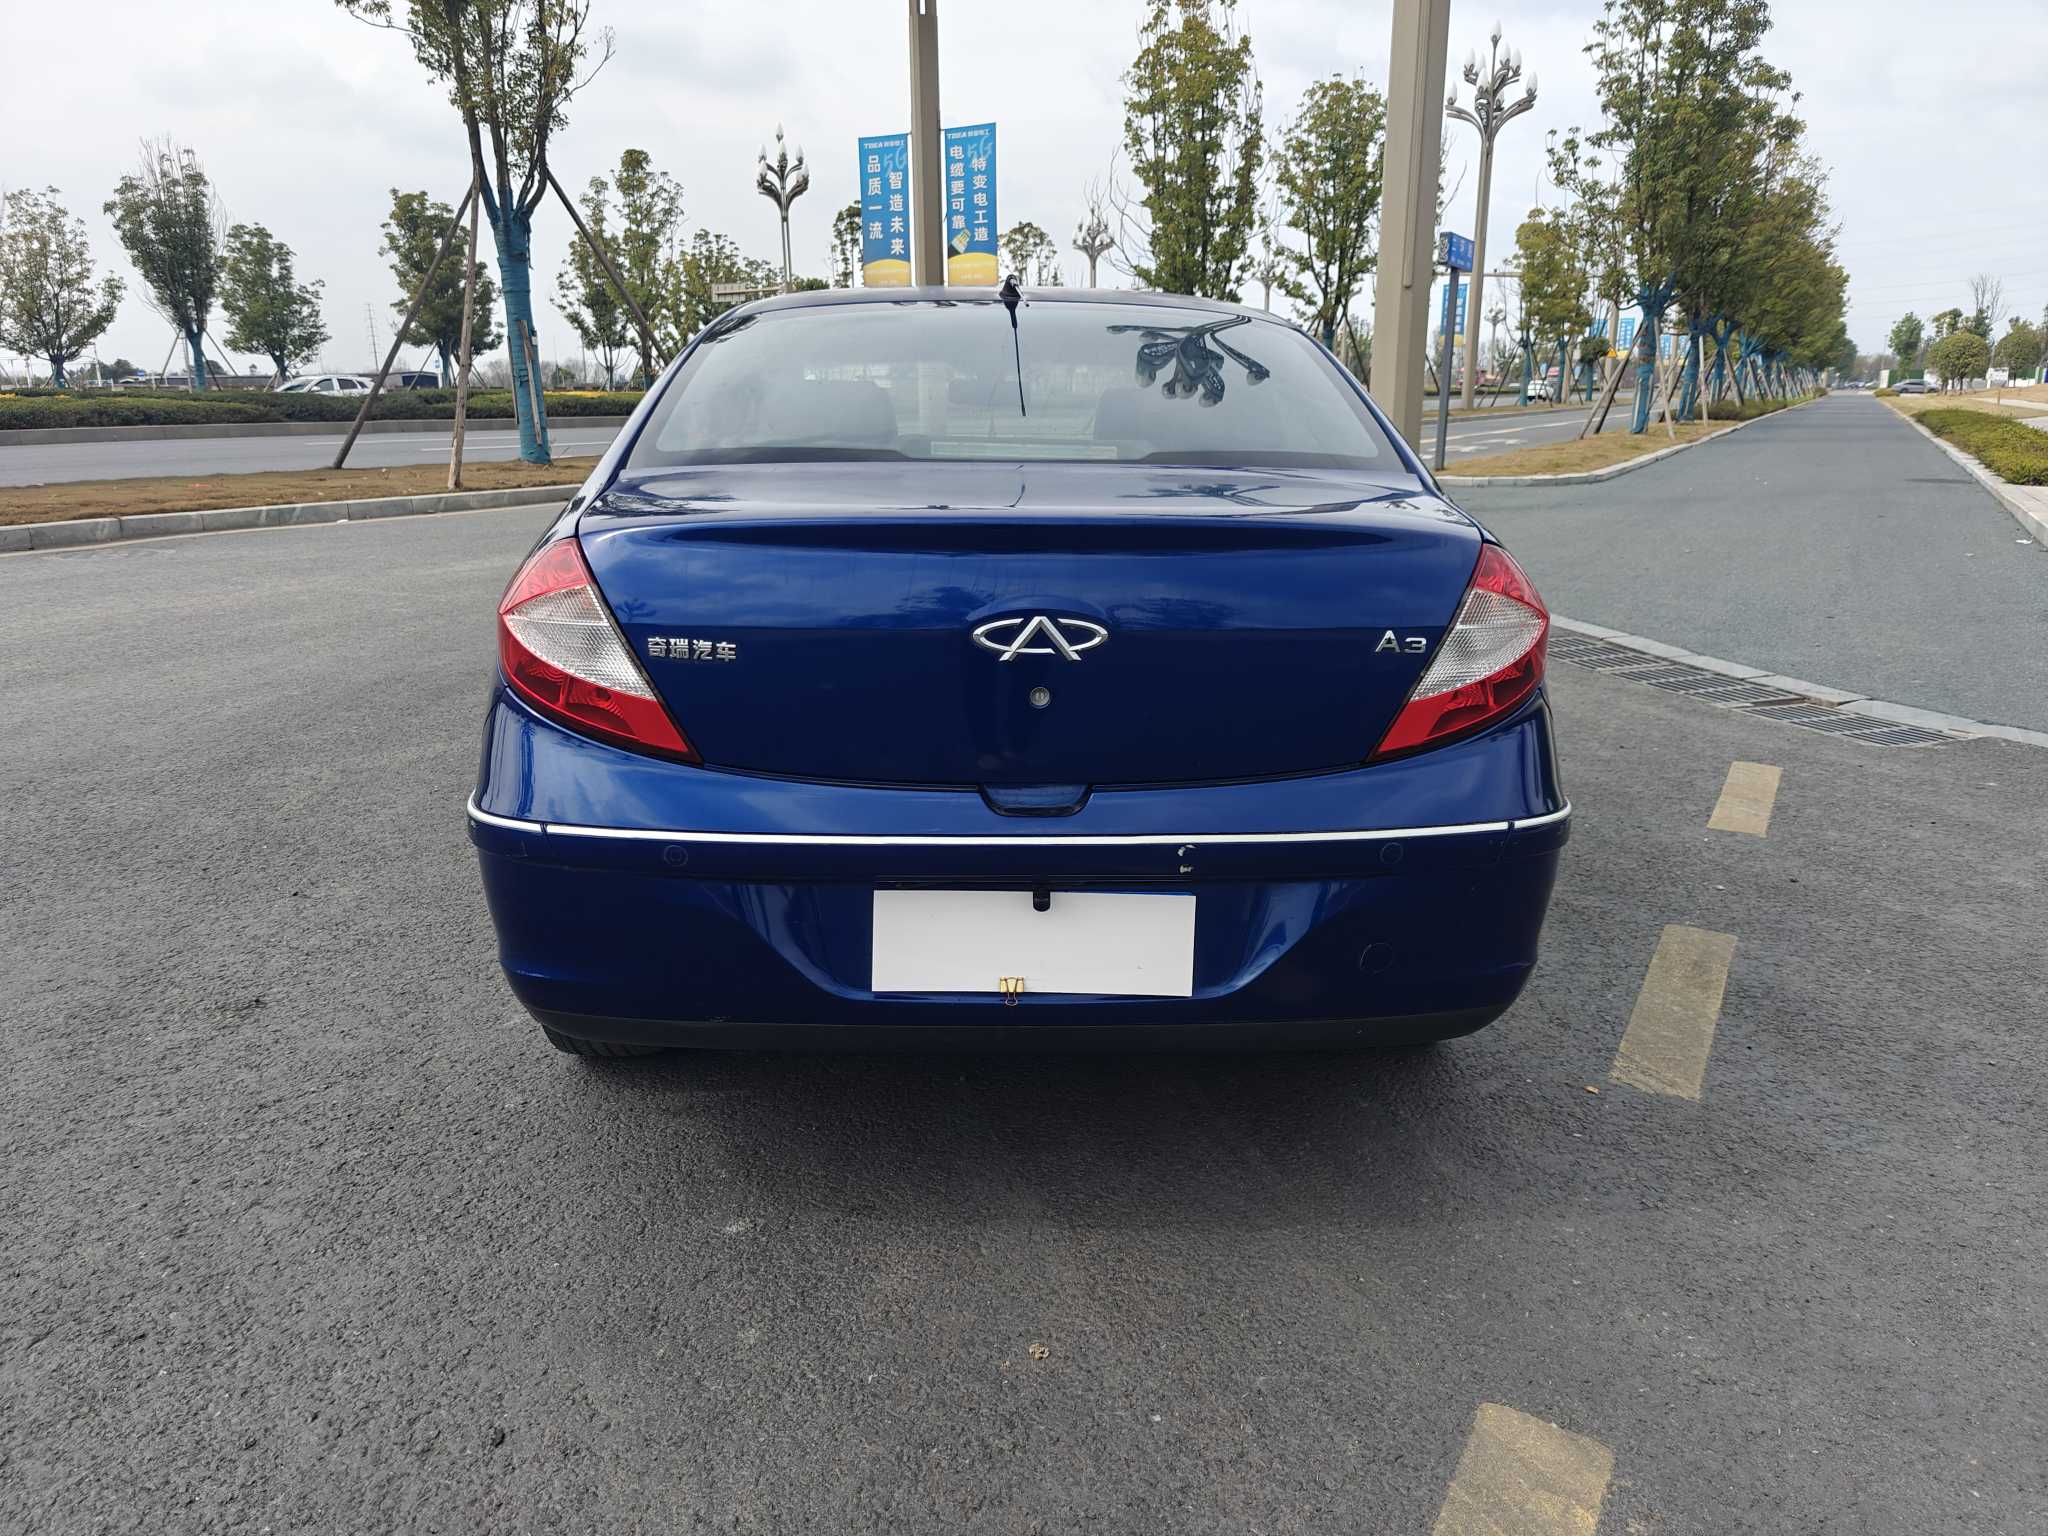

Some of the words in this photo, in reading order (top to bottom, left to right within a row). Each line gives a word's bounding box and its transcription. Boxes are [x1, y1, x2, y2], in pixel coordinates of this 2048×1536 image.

[867, 155, 884, 240] 品质一流
[888, 171, 905, 256] 智造未来
[972, 157, 989, 242] 特变电工造
[647, 636, 737, 662] 奇瑞汽车
[1375, 629, 1427, 654] A3
